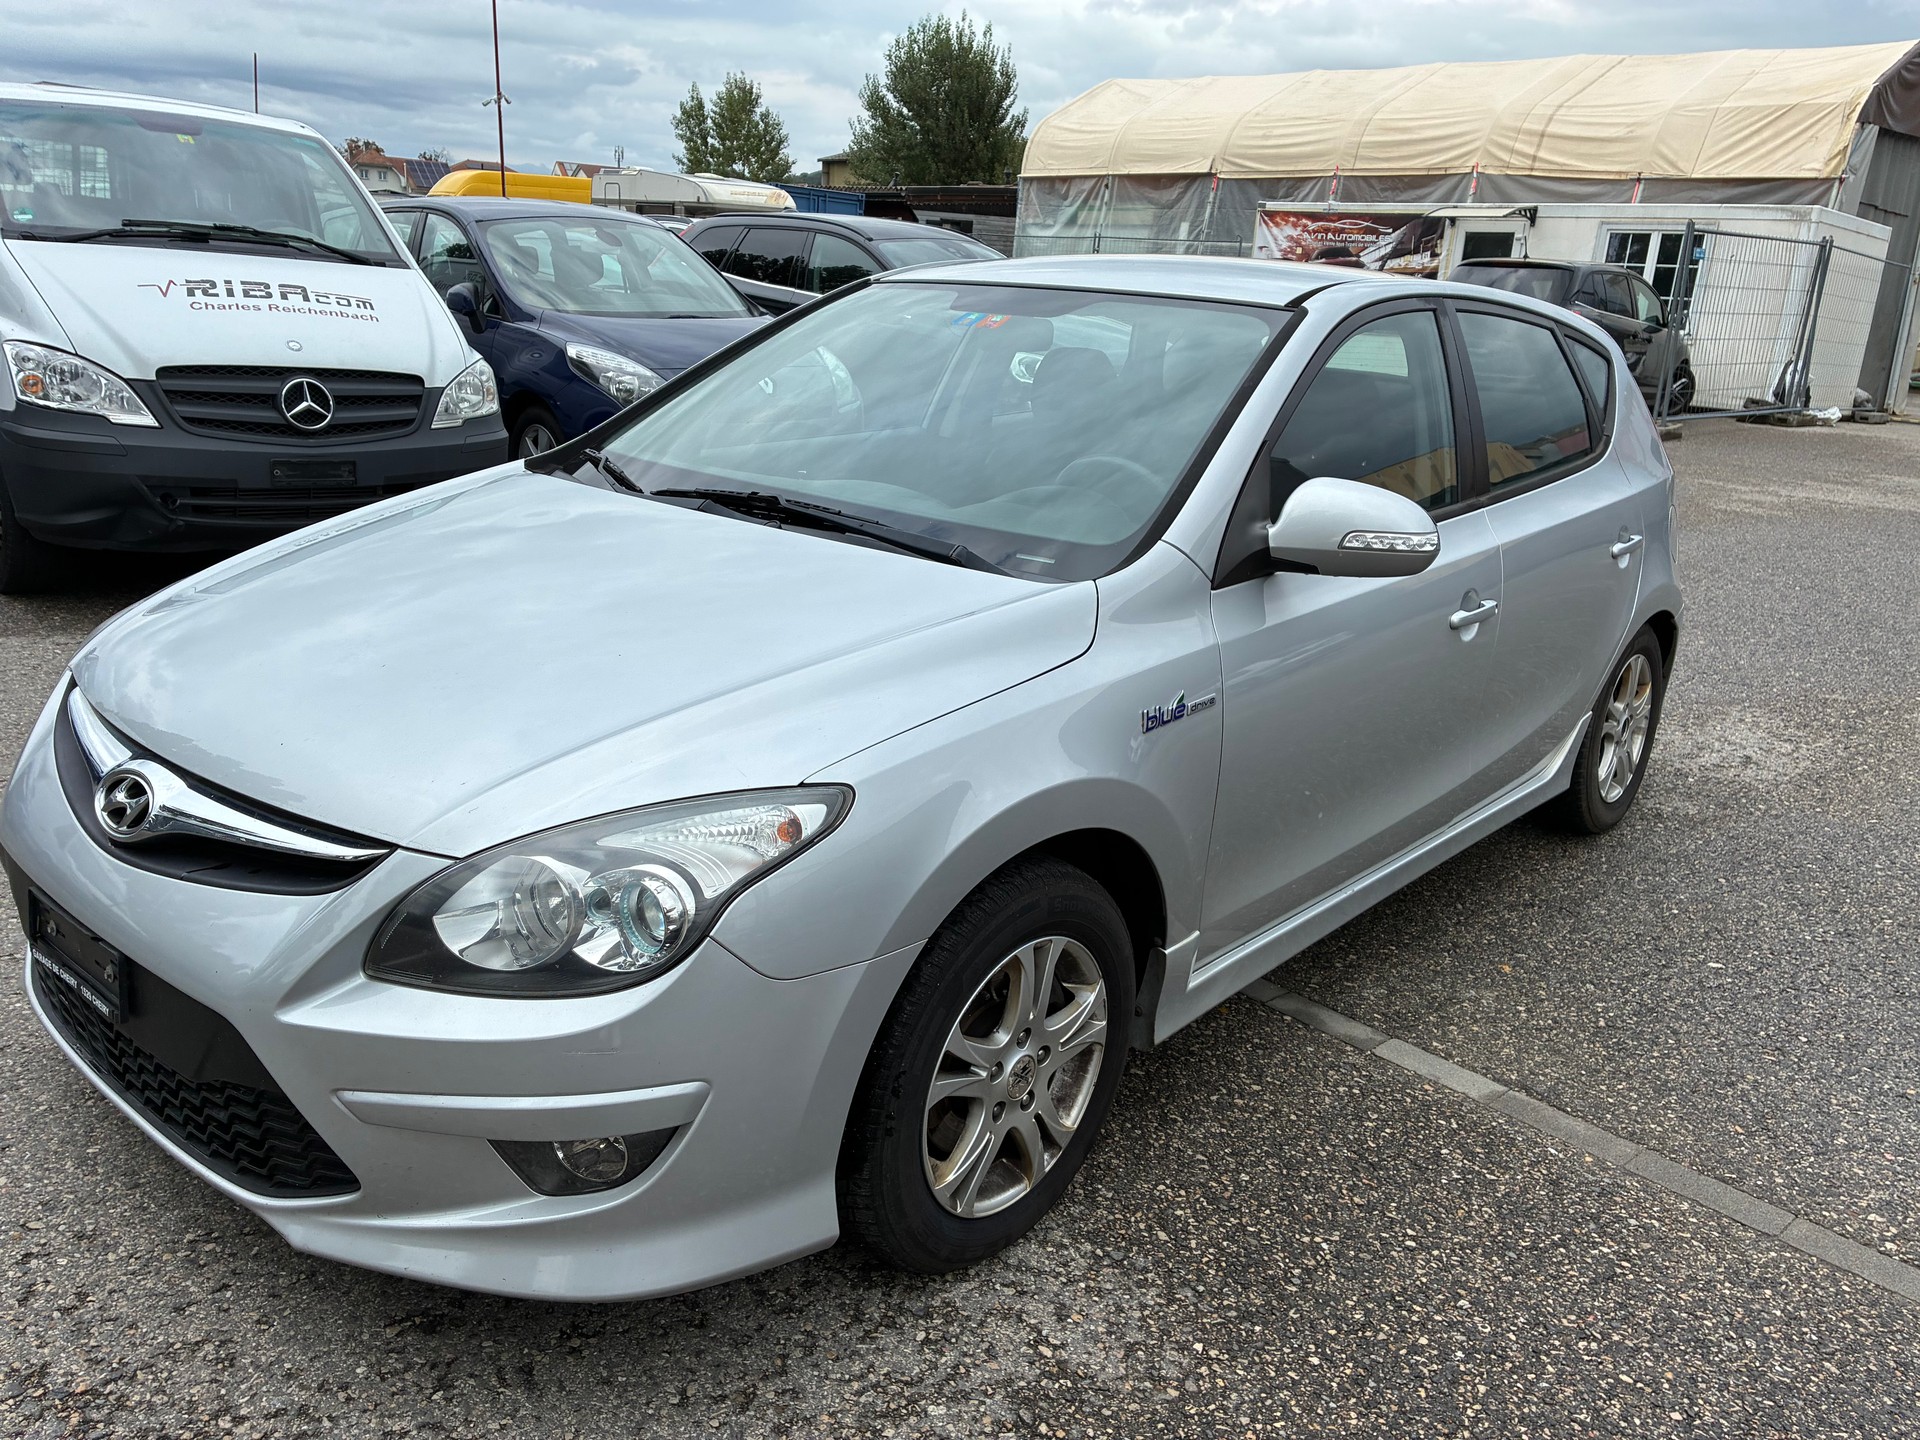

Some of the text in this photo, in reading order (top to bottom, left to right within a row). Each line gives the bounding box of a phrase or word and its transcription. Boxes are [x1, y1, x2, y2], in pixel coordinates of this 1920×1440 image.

[190, 301, 380, 322] Charles Reichenbach
[1142, 697, 1215, 734] blue drive
[32, 948, 52, 969] GARAGE
[52, 963, 60, 975] DE
